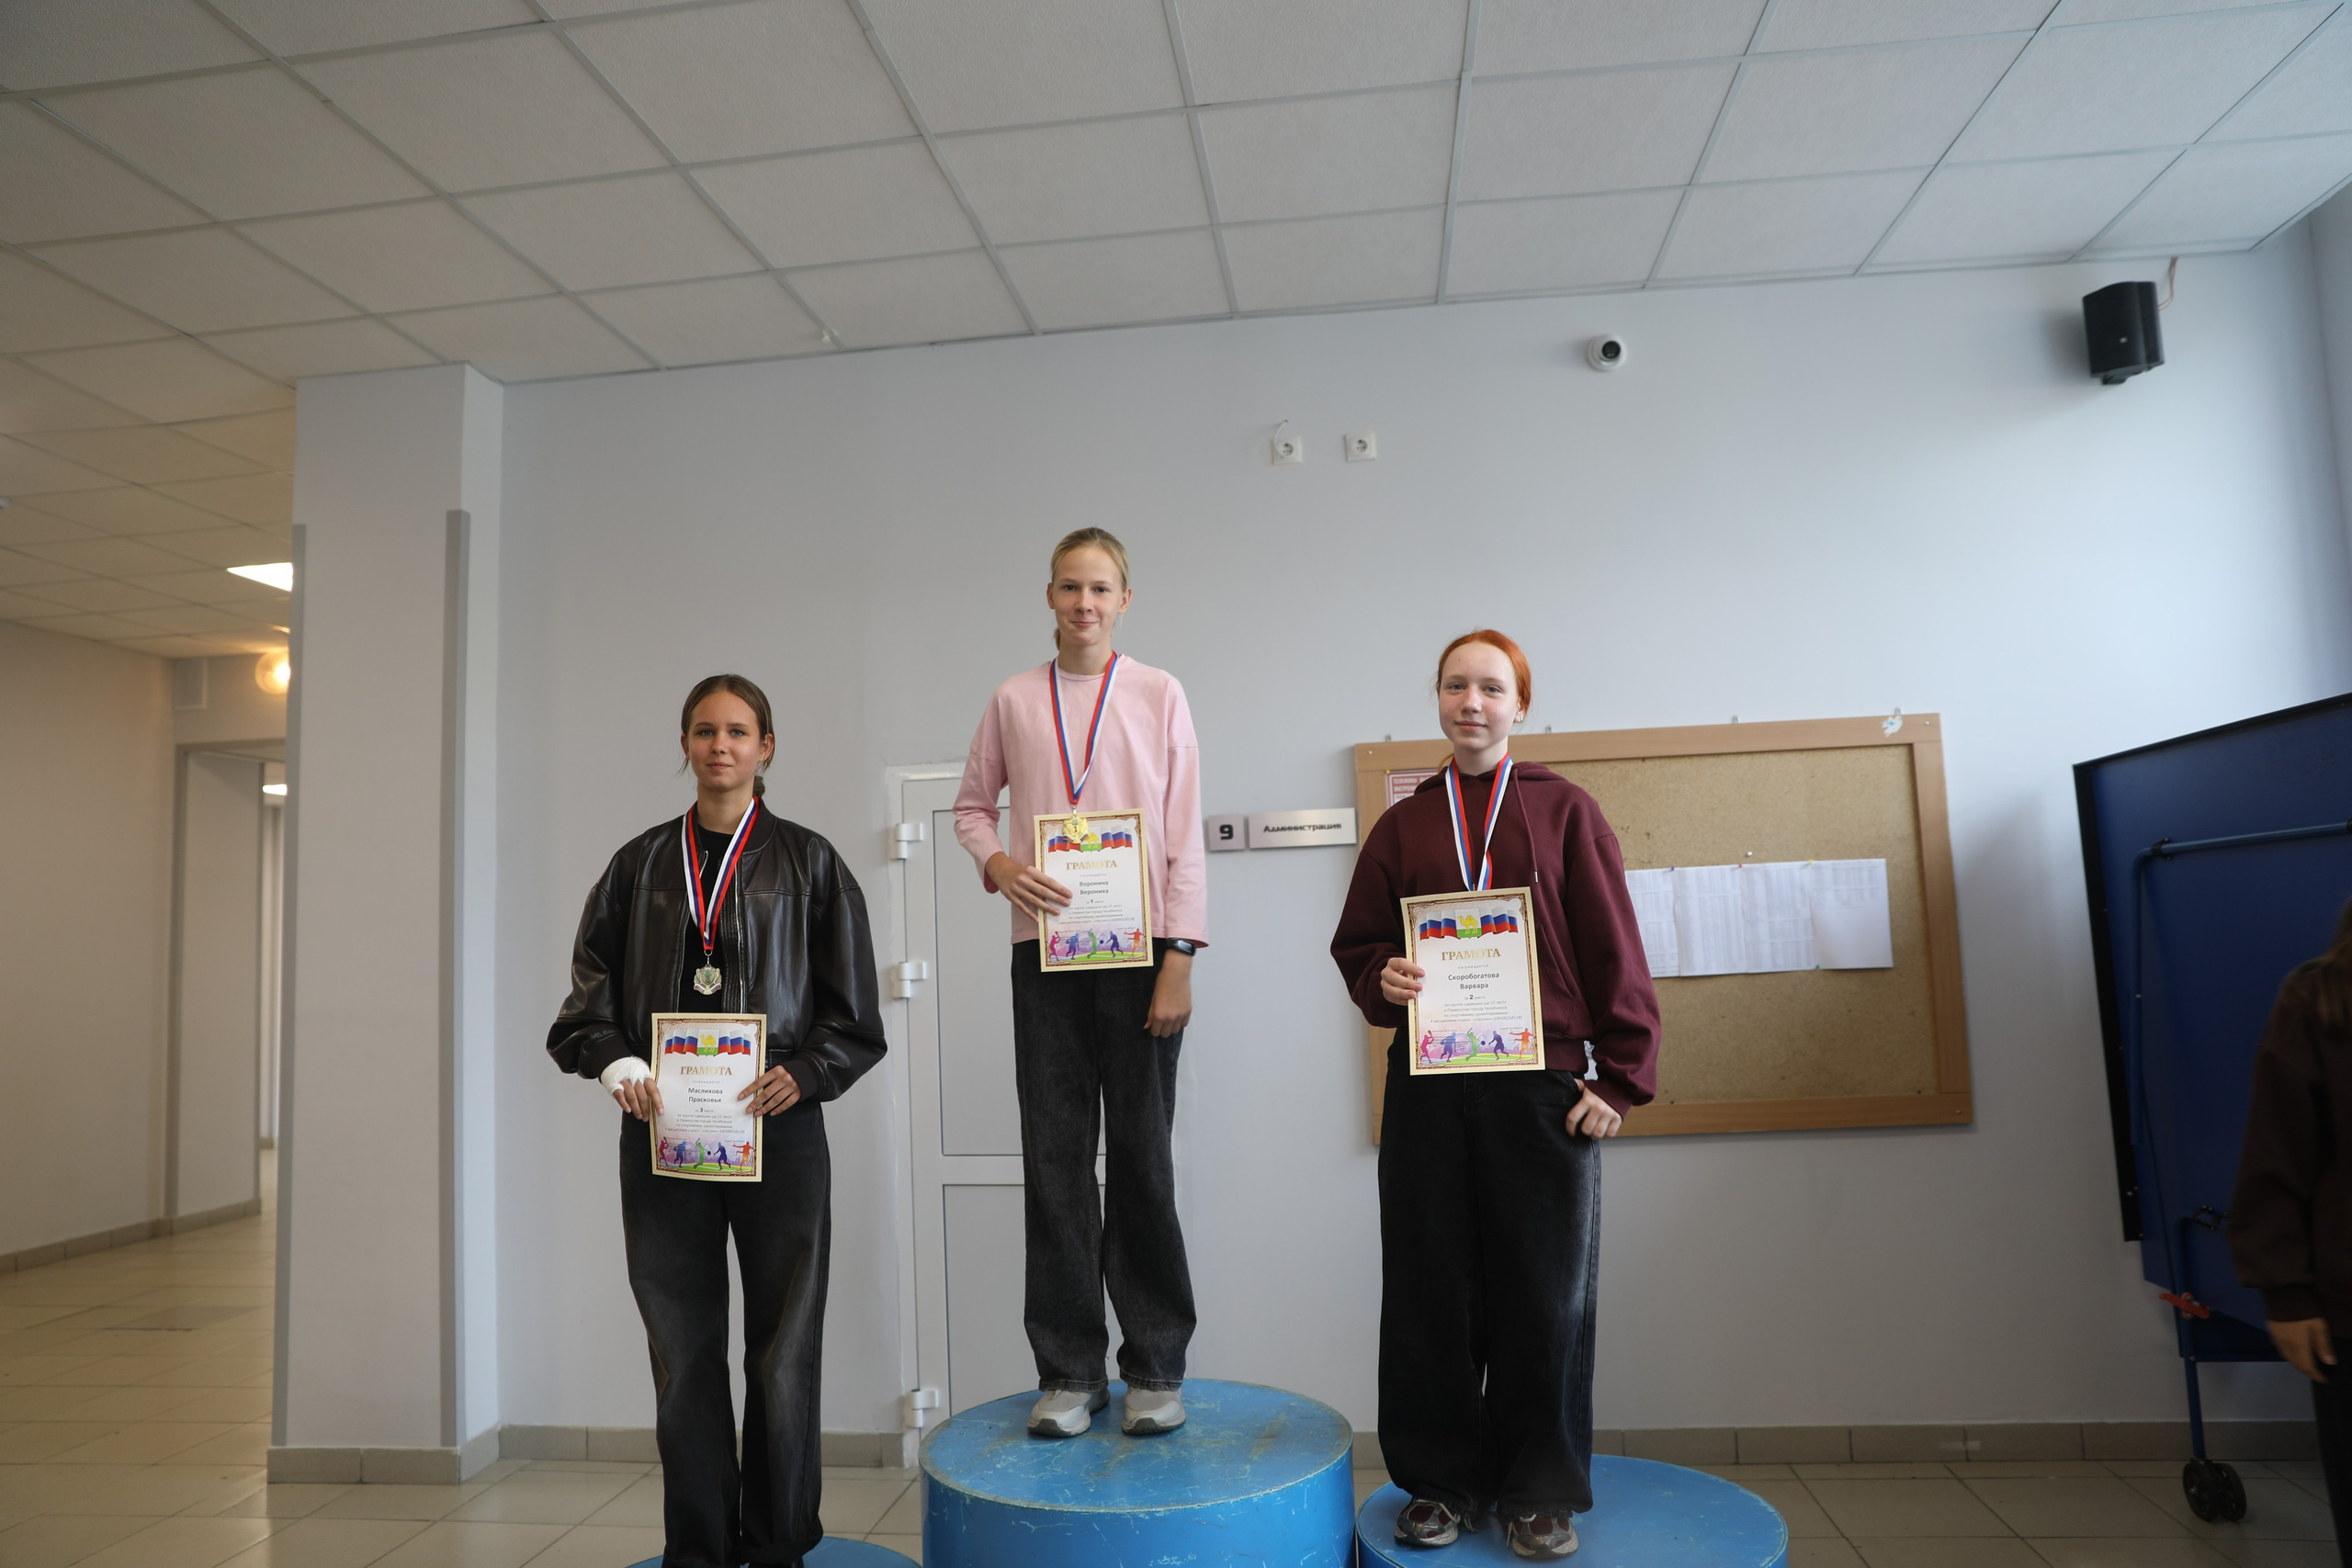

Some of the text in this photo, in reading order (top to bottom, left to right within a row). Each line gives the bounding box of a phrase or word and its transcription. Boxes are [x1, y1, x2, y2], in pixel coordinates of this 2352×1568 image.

[1219, 824, 1234, 840] 9
[1263, 823, 1342, 833] Администрация
[1066, 860, 1117, 870] ГРАМОТА
[1441, 948, 1502, 961] ГРАМОТА
[1448, 973, 1499, 981] Скоробогатова
[680, 1066, 733, 1075] ГРАМОТА
